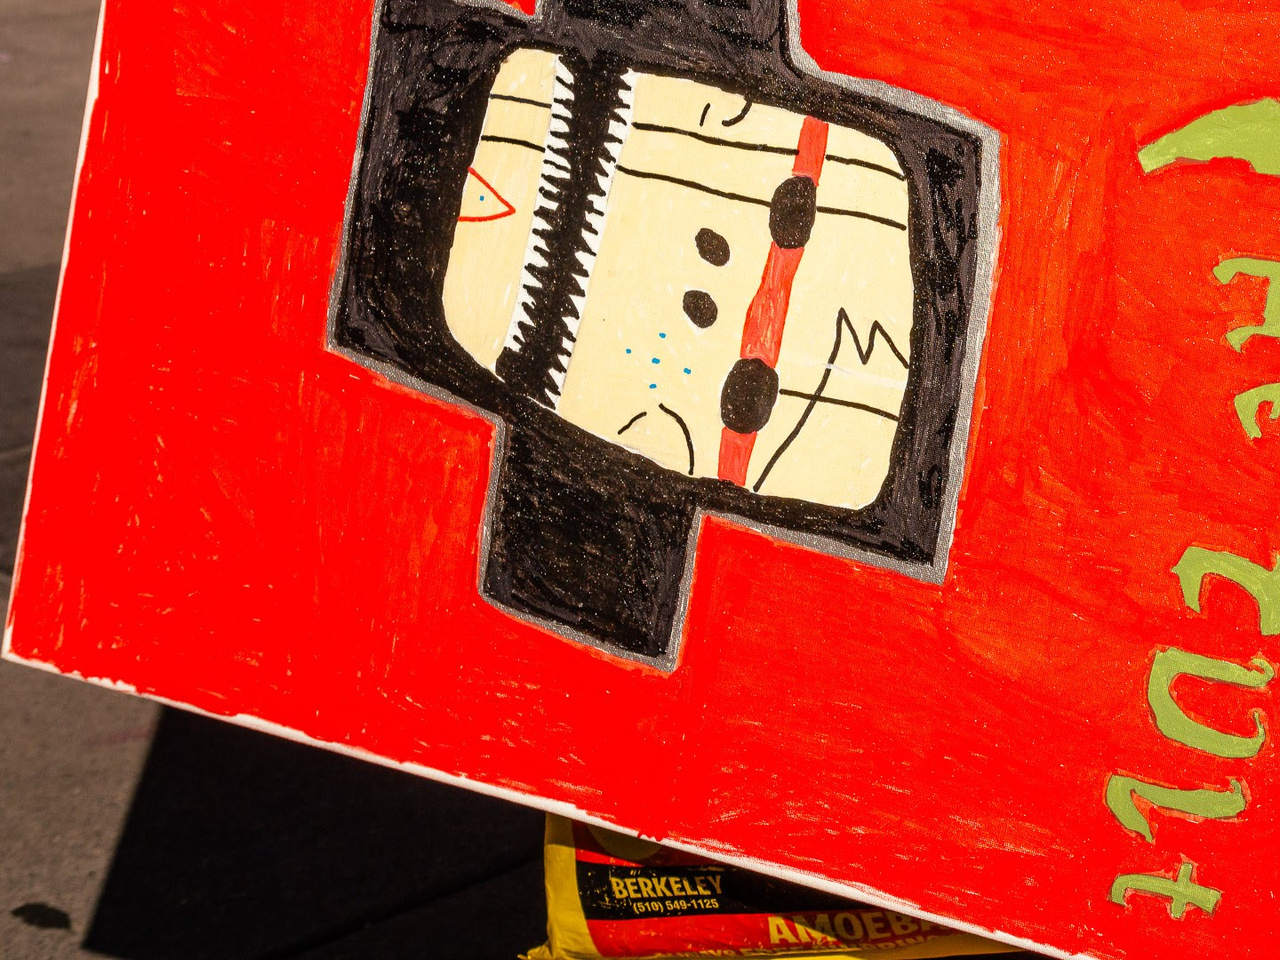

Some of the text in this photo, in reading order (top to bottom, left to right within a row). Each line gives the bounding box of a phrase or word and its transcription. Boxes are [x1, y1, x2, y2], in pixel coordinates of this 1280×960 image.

[610, 875, 722, 899] BERKELEY
[632, 898, 719, 914] (510) 549-1125
